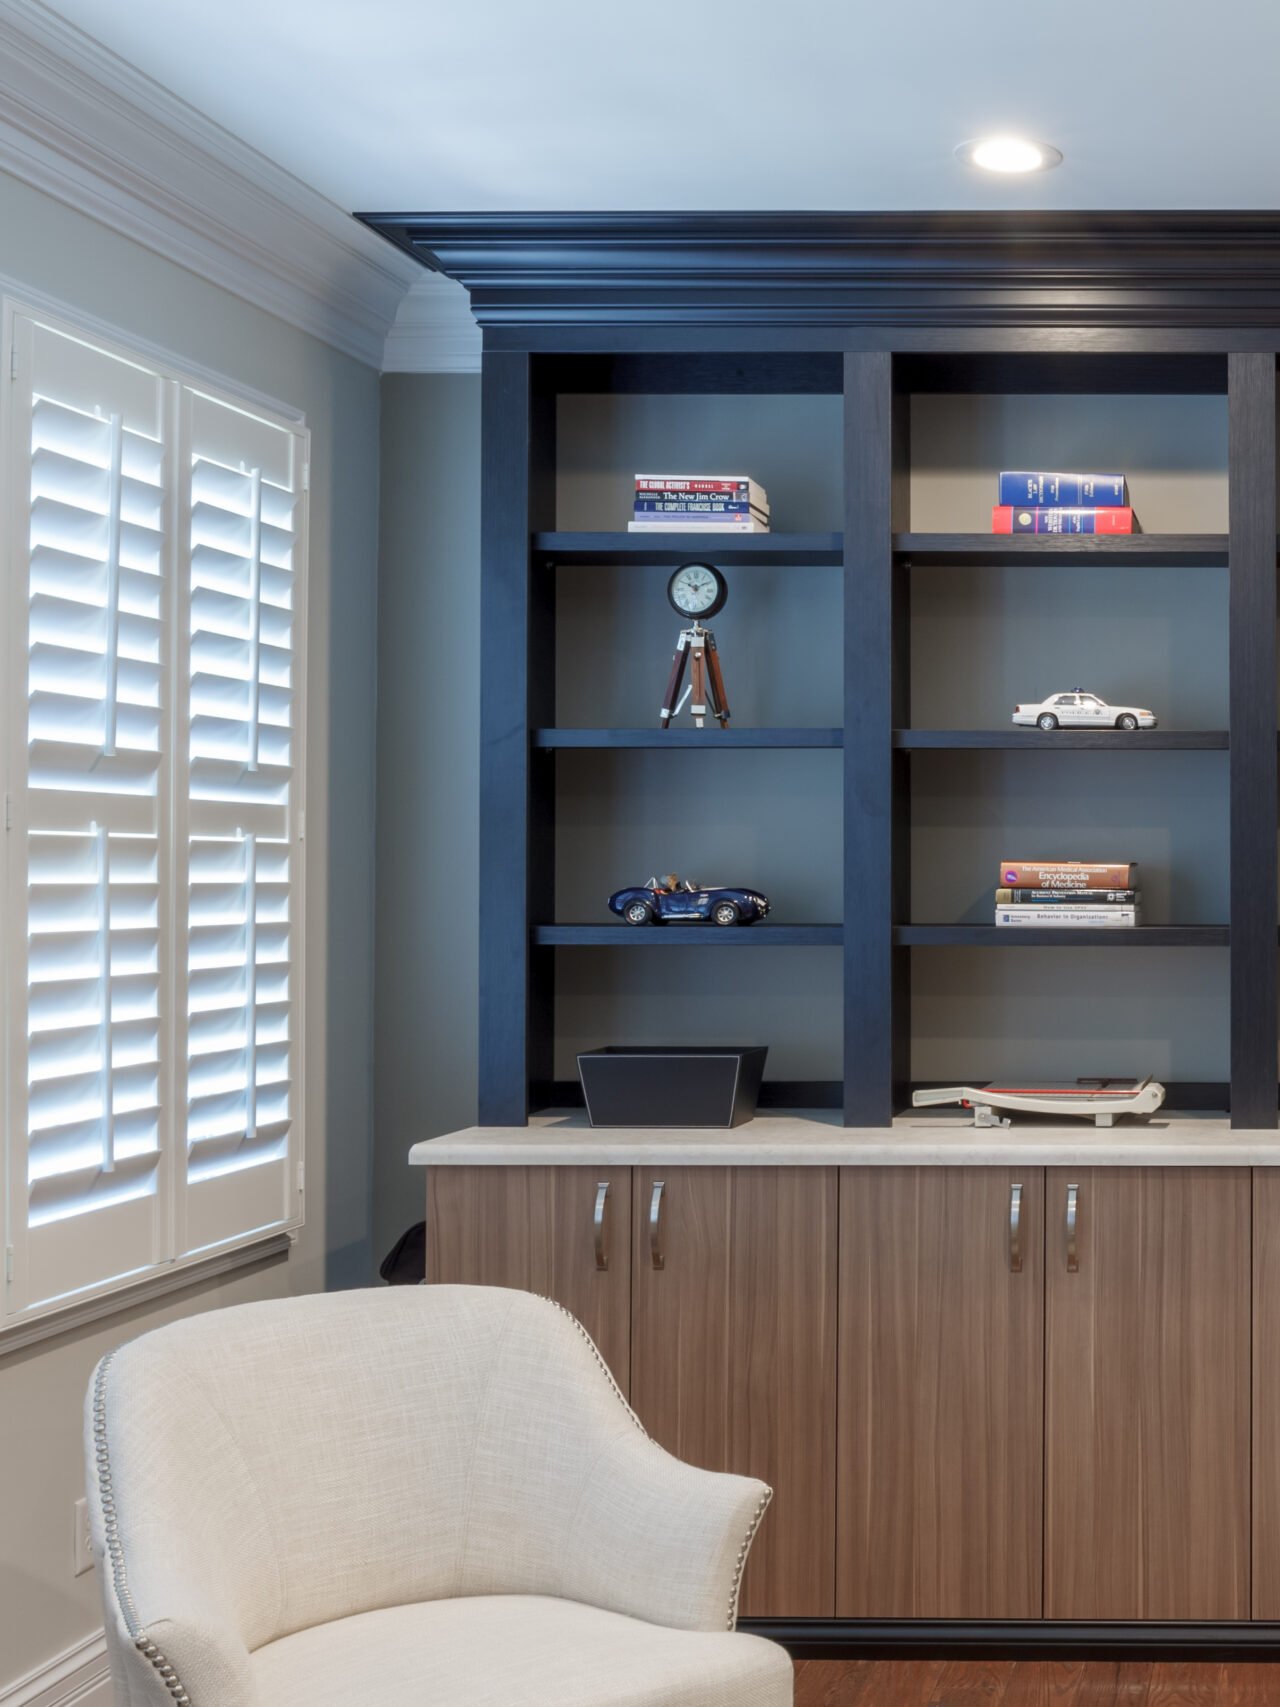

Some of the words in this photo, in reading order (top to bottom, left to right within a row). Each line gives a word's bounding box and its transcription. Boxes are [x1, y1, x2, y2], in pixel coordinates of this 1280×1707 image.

[639, 480, 649, 489] THE
[663, 492, 678, 500] The
[678, 492, 696, 500] New
[696, 492, 709, 501] Jim
[709, 492, 730, 501] Crow
[655, 502, 664, 511] THE
[664, 502, 686, 511] COMPLETE
[687, 502, 711, 511] FRANCHISE
[712, 502, 725, 511] BOOK
[1038, 872, 1089, 882] Encyclopedia
